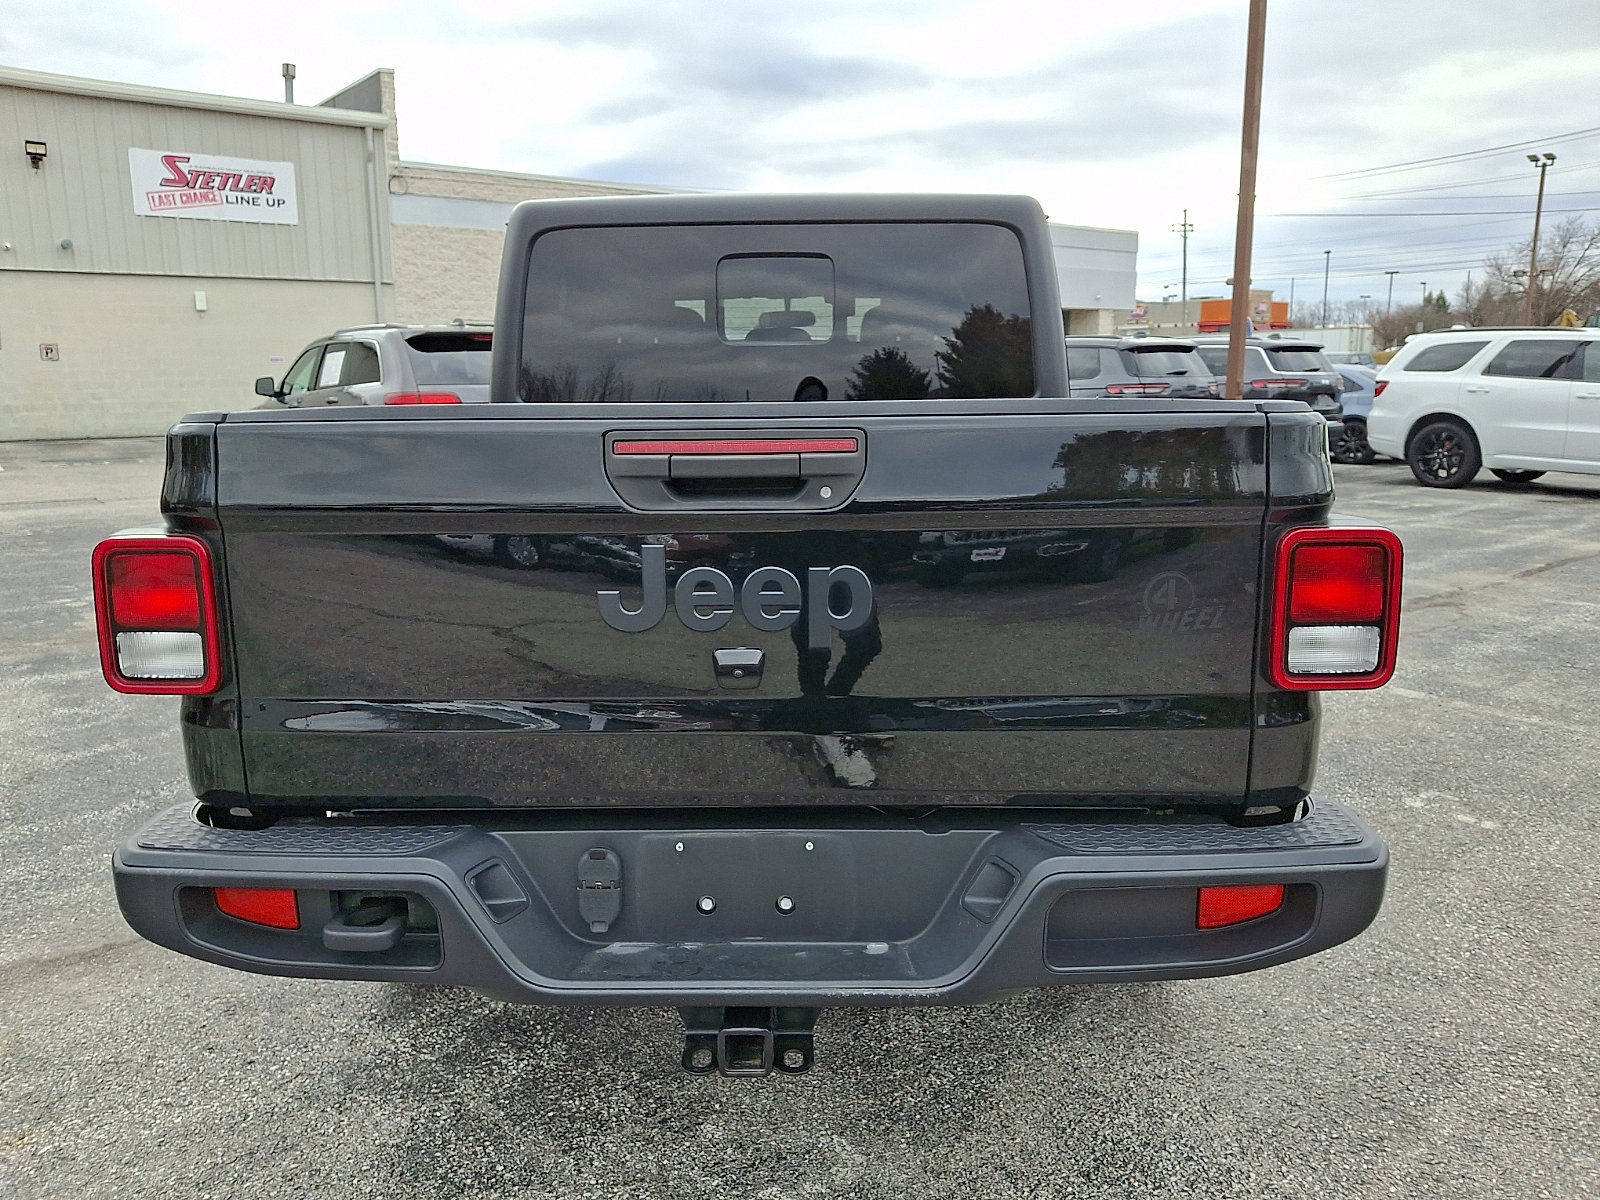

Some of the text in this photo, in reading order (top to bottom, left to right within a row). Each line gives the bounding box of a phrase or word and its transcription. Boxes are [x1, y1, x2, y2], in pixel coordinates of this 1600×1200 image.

[160, 155, 276, 194] STETLER
[151, 190, 286, 208] LAST CHANCE LINE UP
[597, 544, 873, 649] Jeep
[1138, 605, 1225, 633] WHEEL
